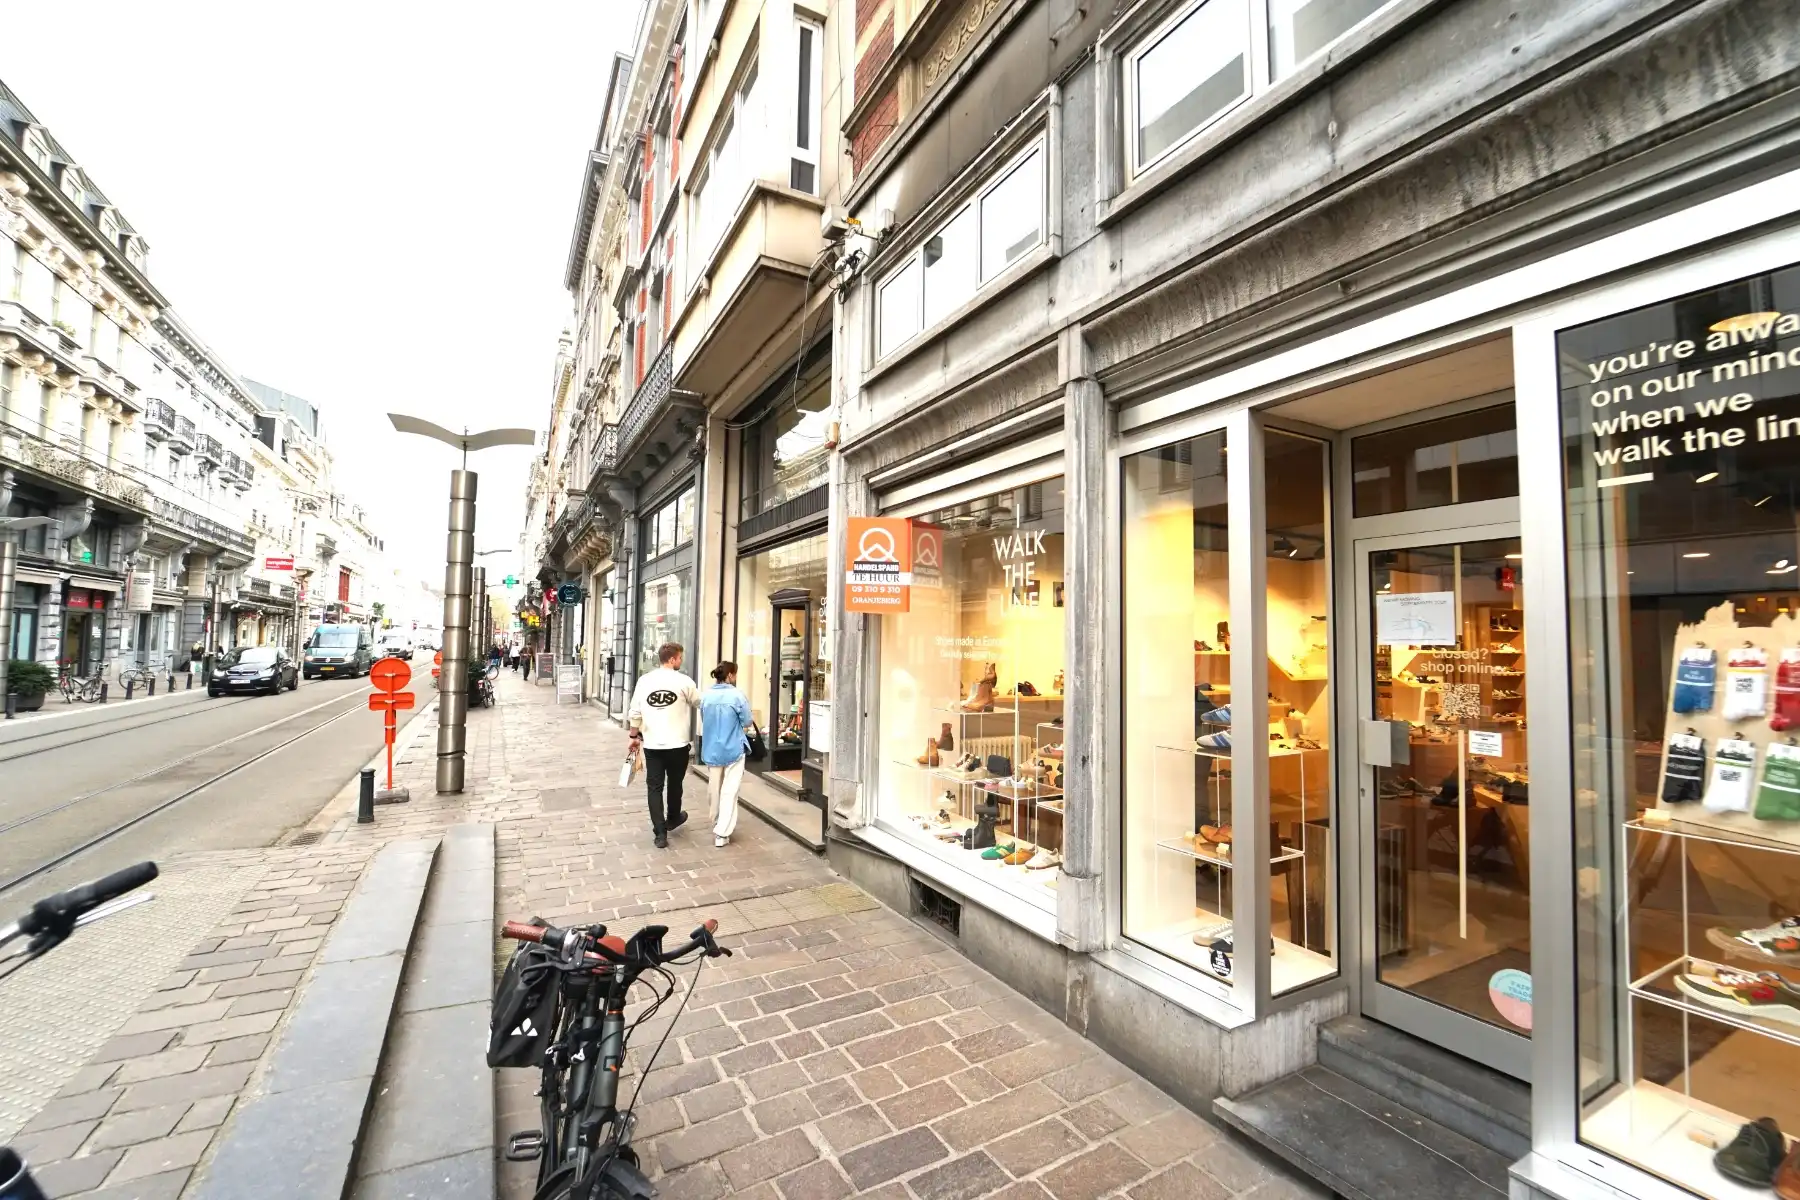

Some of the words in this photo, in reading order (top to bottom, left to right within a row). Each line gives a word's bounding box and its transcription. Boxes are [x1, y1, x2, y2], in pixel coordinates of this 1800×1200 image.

[1588, 339, 1695, 384] you're
[1590, 383, 1633, 408] on
[1641, 369, 1702, 397] our
[1592, 405, 1685, 437] when
[1694, 392, 1754, 418] we
[1593, 435, 1673, 467] walk
[1681, 427, 1746, 453] the
[1016, 503, 1020, 529] I
[994, 528, 1047, 561] WALK
[852, 573, 867, 582] TE
[869, 573, 900, 583] HUUR
[1002, 561, 1035, 588] THE
[955, 635, 974, 646] made
[1432, 648, 1489, 659] closed?
[1420, 661, 1454, 674] shop
[649, 693, 674, 705] SUS
